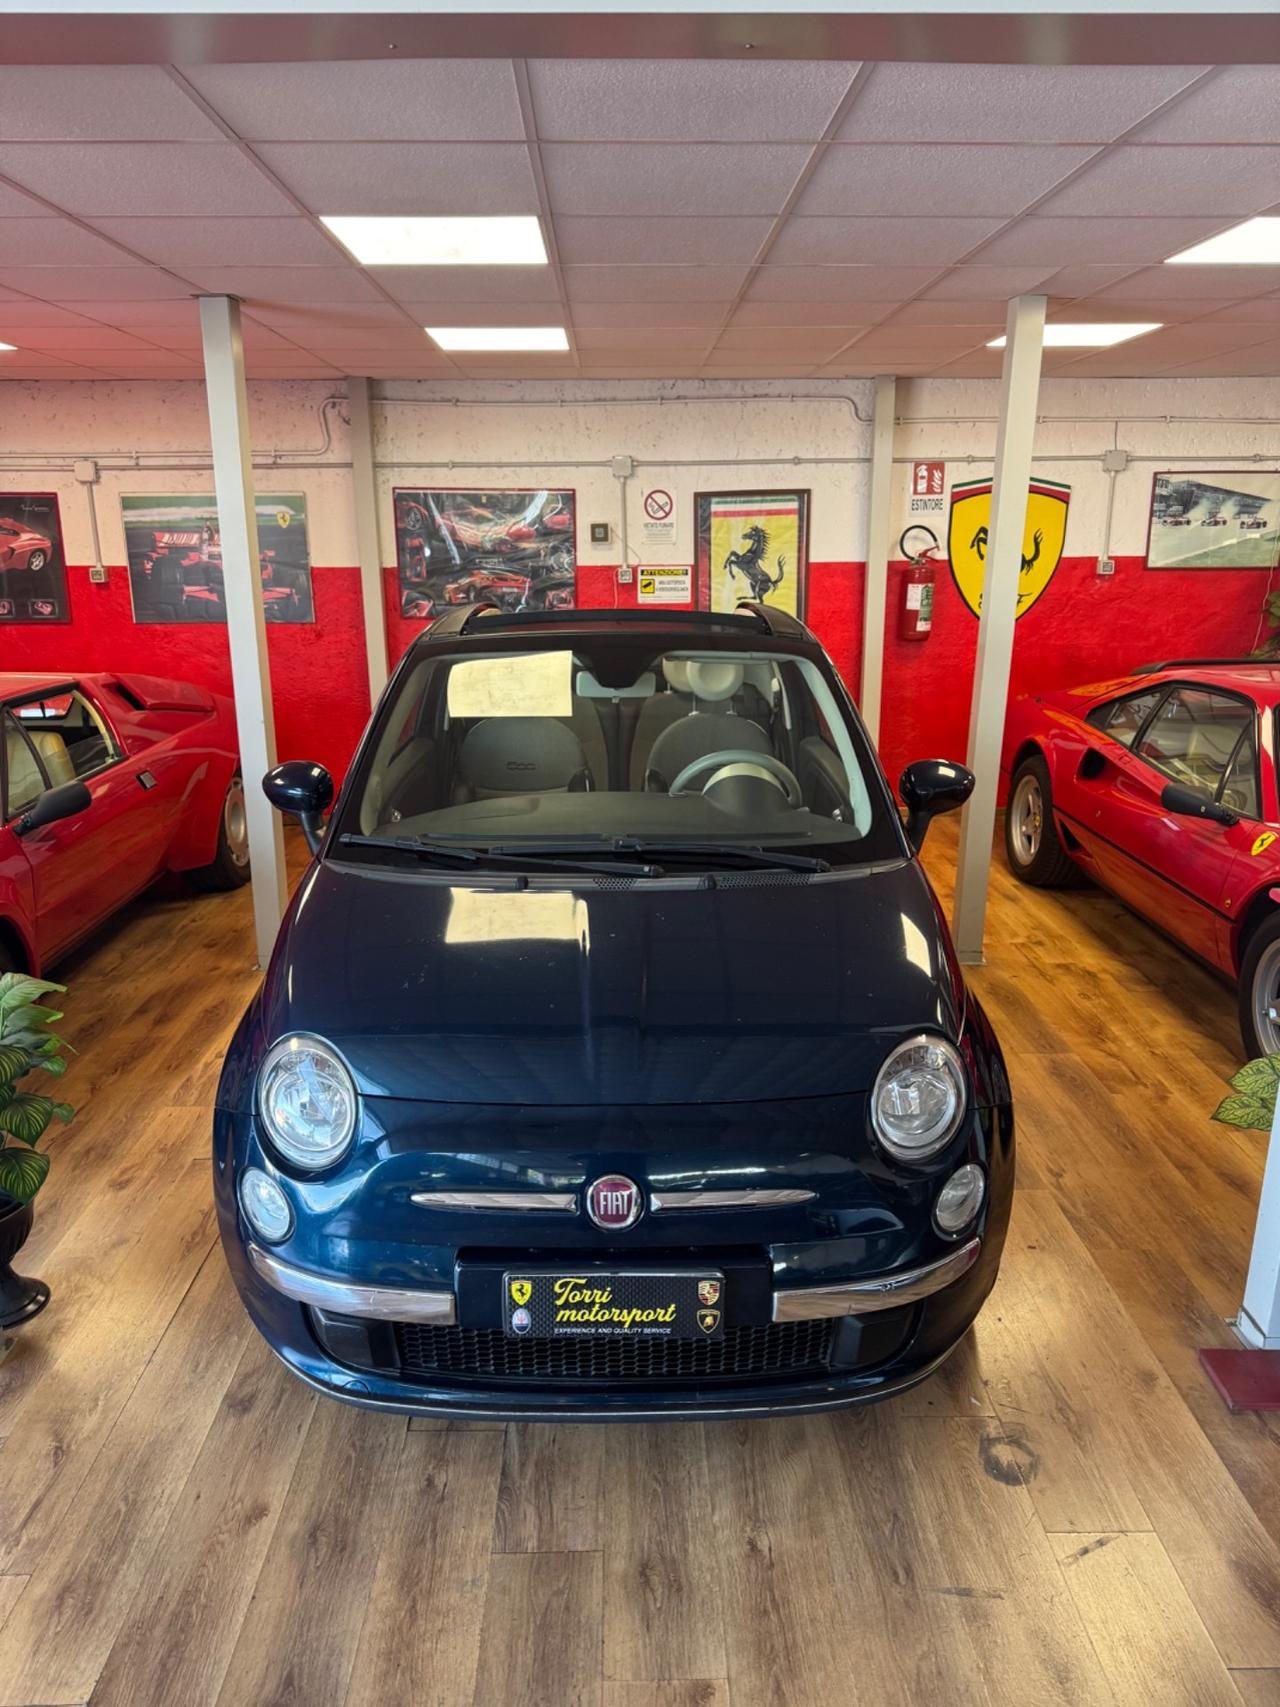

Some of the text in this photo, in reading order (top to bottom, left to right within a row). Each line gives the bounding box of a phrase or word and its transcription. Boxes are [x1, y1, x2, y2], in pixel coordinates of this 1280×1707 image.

[911, 498, 944, 511] ESTINTORE
[599, 1191, 629, 1216] FIAT
[554, 1278, 612, 1306] Torri
[555, 1303, 676, 1328] motorsport
